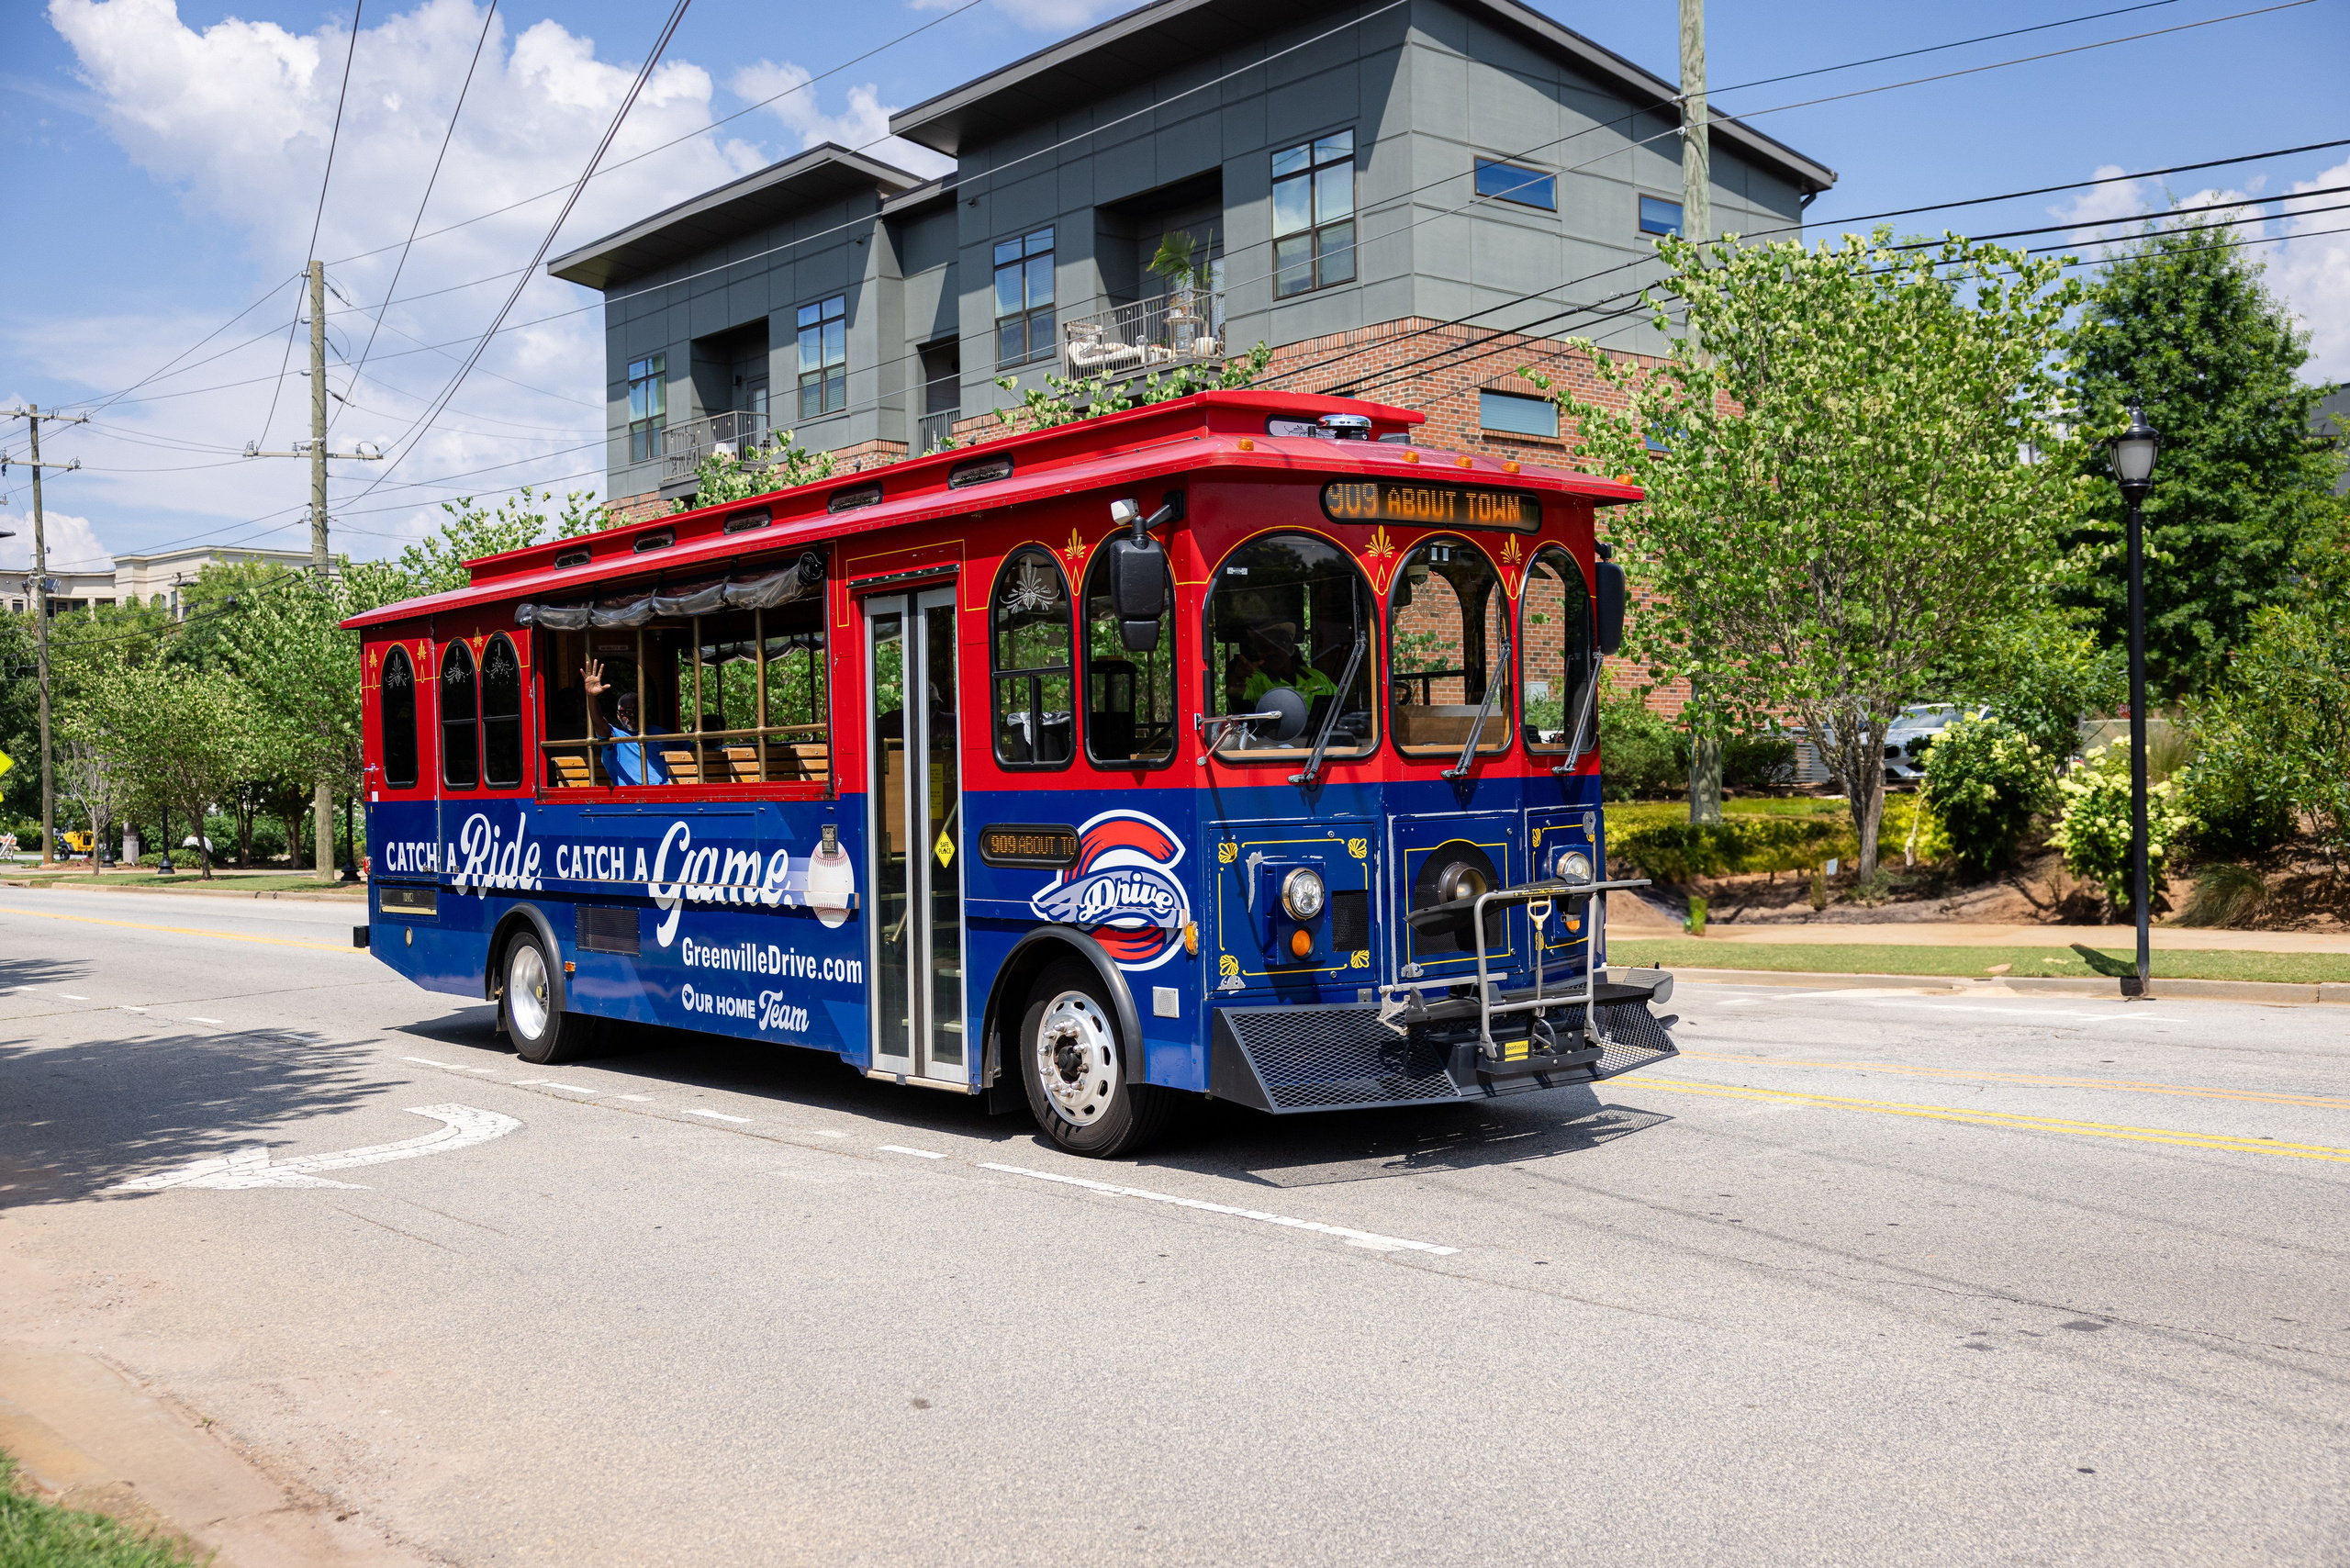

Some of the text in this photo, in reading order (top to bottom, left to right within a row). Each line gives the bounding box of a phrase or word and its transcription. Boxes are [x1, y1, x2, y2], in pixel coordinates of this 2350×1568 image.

[1328, 483, 1520, 521] 909 ABOUT TOWN
[991, 835, 1076, 855] 909 ABOUT TO
[386, 842, 438, 872] CATCH
[446, 843, 457, 872] A
[452, 812, 543, 900] Ride.
[556, 845, 624, 879] CATCH
[632, 847, 648, 881] A
[648, 821, 798, 947] Game.
[1079, 872, 1173, 922] Drive
[682, 936, 862, 983] GreenvilleDrive.com
[682, 983, 810, 1032] OUR HOME Team
